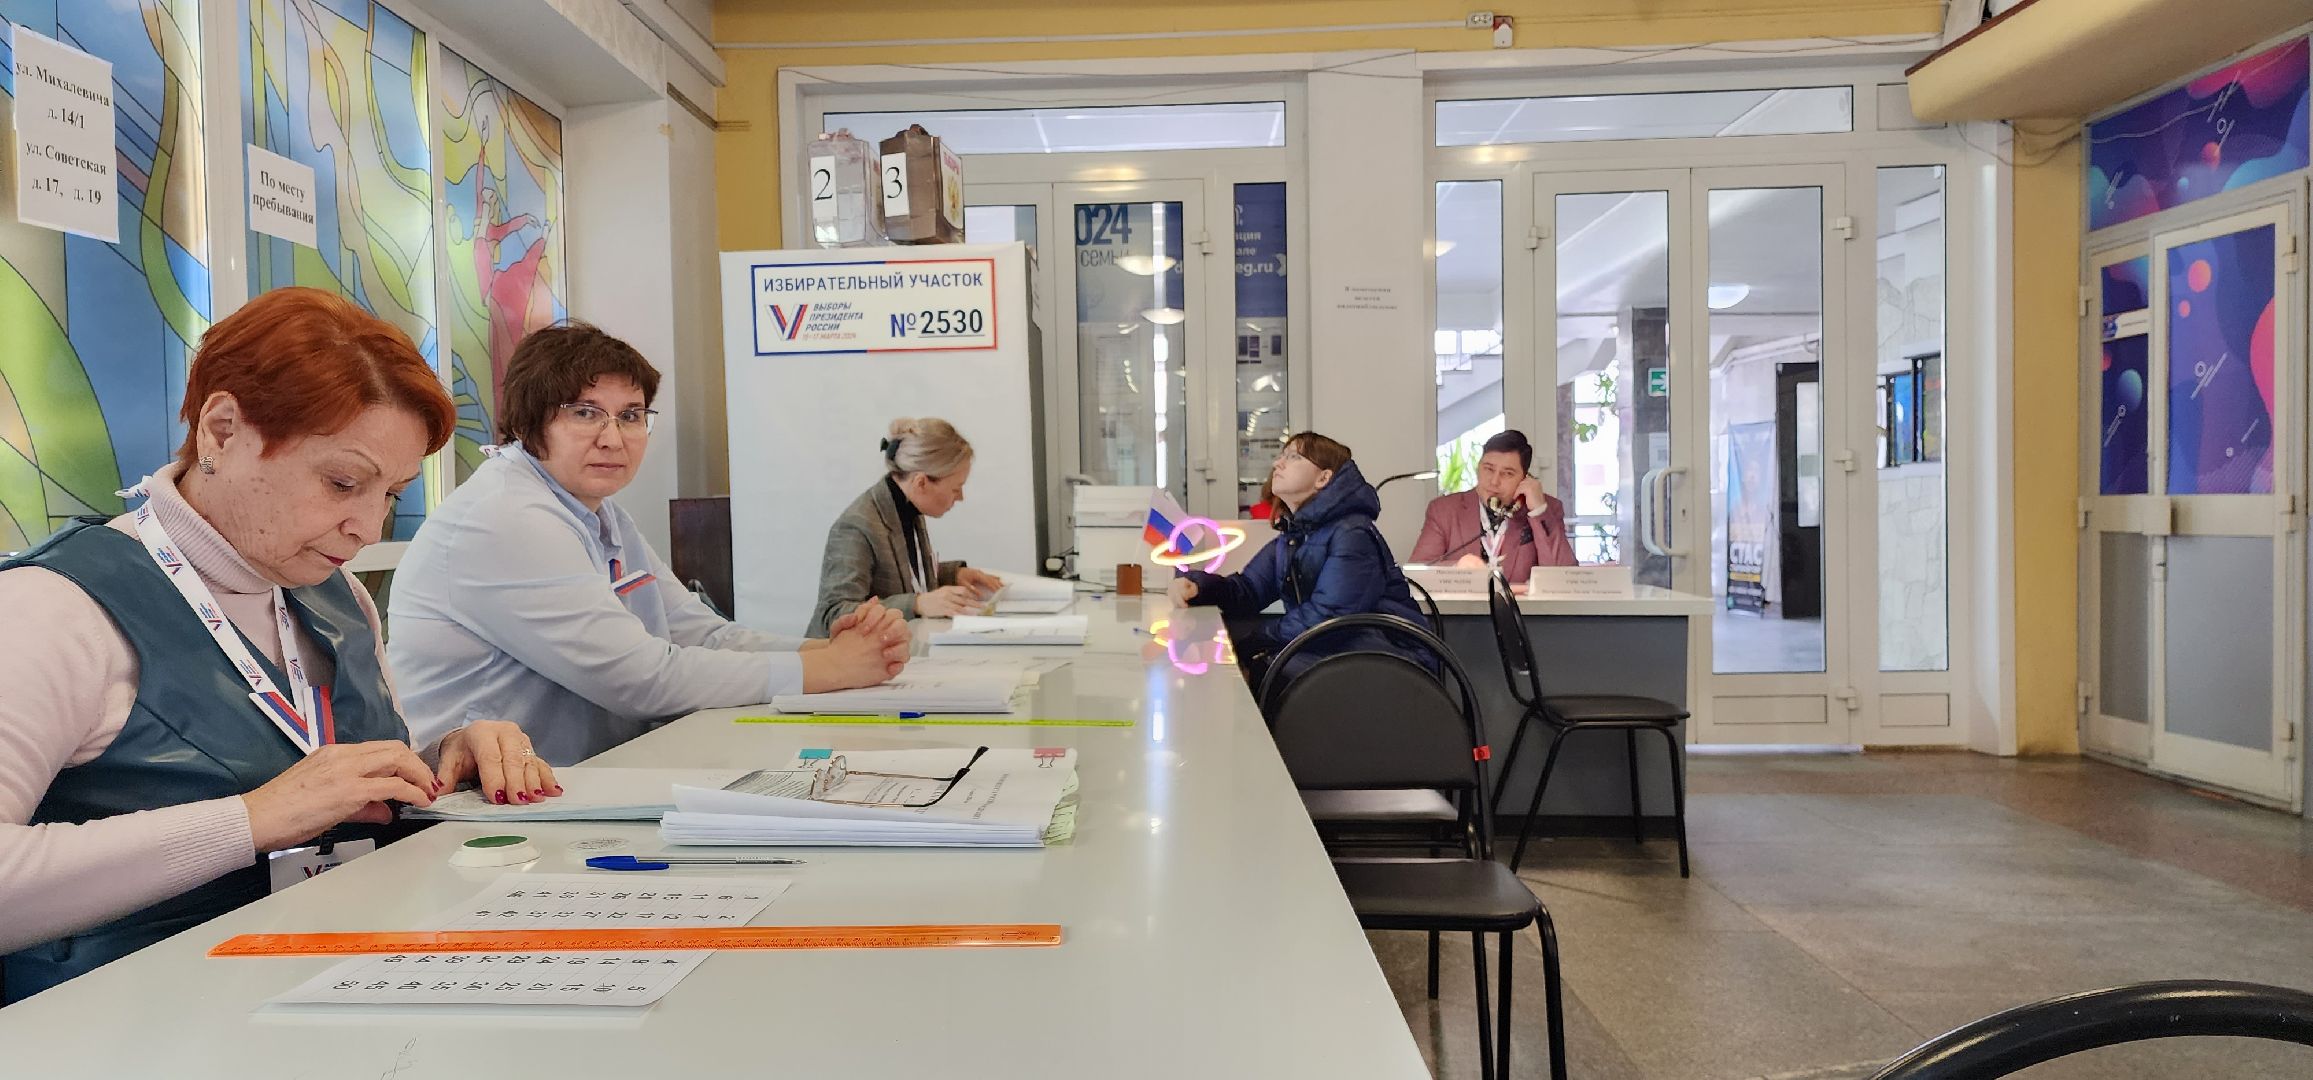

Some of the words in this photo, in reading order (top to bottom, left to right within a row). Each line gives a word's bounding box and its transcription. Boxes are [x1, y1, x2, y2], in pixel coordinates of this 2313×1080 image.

[15, 61, 33, 77] ул.
[36, 65, 110, 107] Михалевича
[47, 107, 58, 120] д.
[61, 107, 86, 130] 14/1
[26, 142, 42, 156] ул.
[45, 144, 107, 176] Советская
[32, 177, 42, 190] д.
[46, 177, 64, 197] 17,
[73, 188, 84, 201] д.
[88, 189, 102, 205] 19
[260, 170, 276, 190] По
[278, 181, 305, 203] месту
[813, 168, 834, 201] 2
[885, 166, 903, 199] 3
[253, 193, 314, 225] пребывания
[763, 271, 904, 292] ИЗБИРАТЕЛЬНЫЙ
[909, 272, 984, 288] УЧАСТОК
[809, 311, 864, 321] ПРЕЗИДЕНТА
[813, 302, 852, 311] ВЫБОРЫ
[805, 322, 840, 332] РОССИИ
